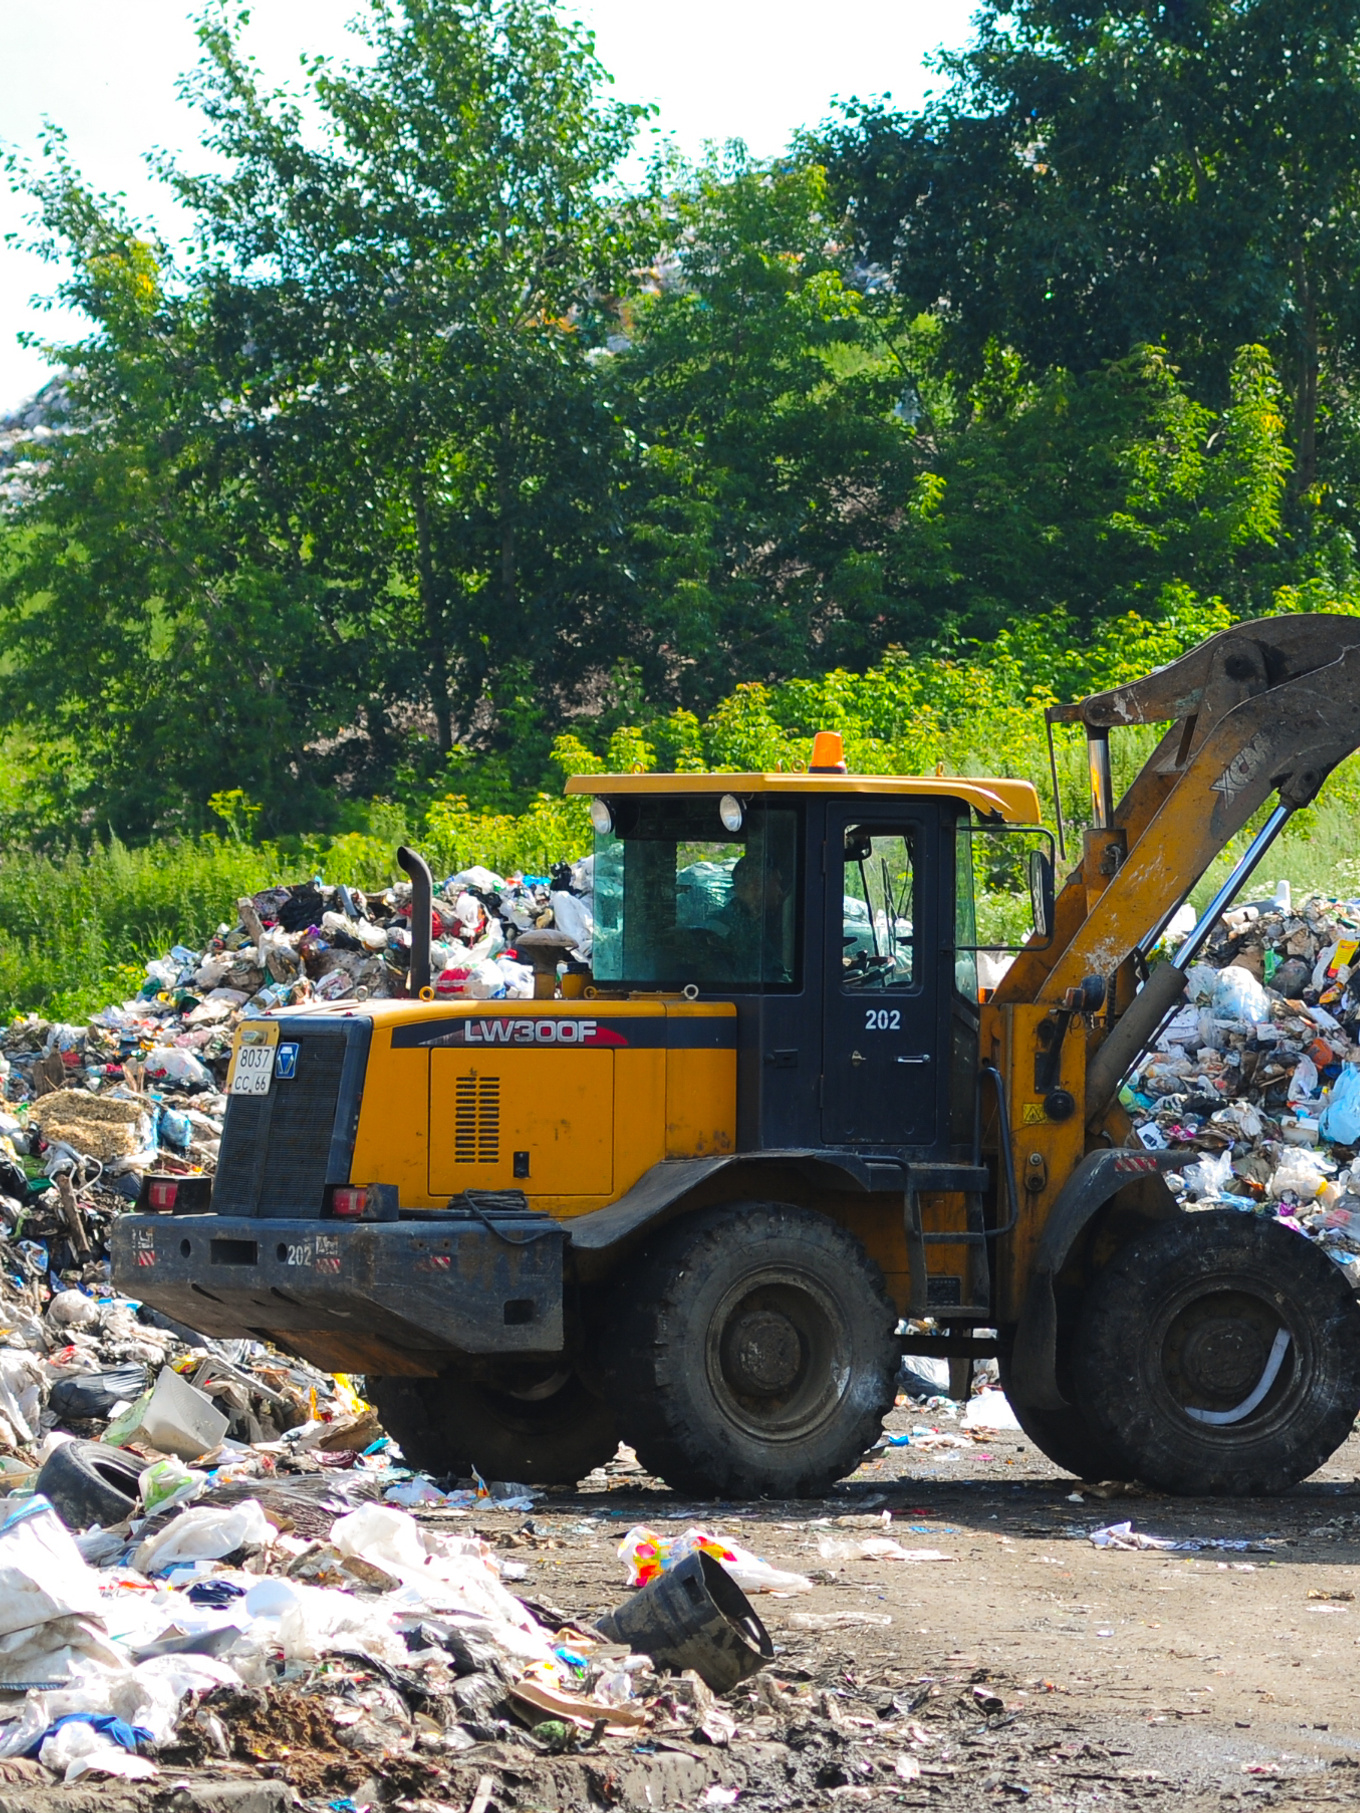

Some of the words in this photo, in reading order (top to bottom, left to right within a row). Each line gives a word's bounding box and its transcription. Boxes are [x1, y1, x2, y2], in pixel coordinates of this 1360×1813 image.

[865, 1009, 901, 1030] 202
[464, 1019, 598, 1043] LW300F
[240, 1048, 271, 1068] 8037
[254, 1075, 267, 1091] 66
[287, 1244, 313, 1267] 202
